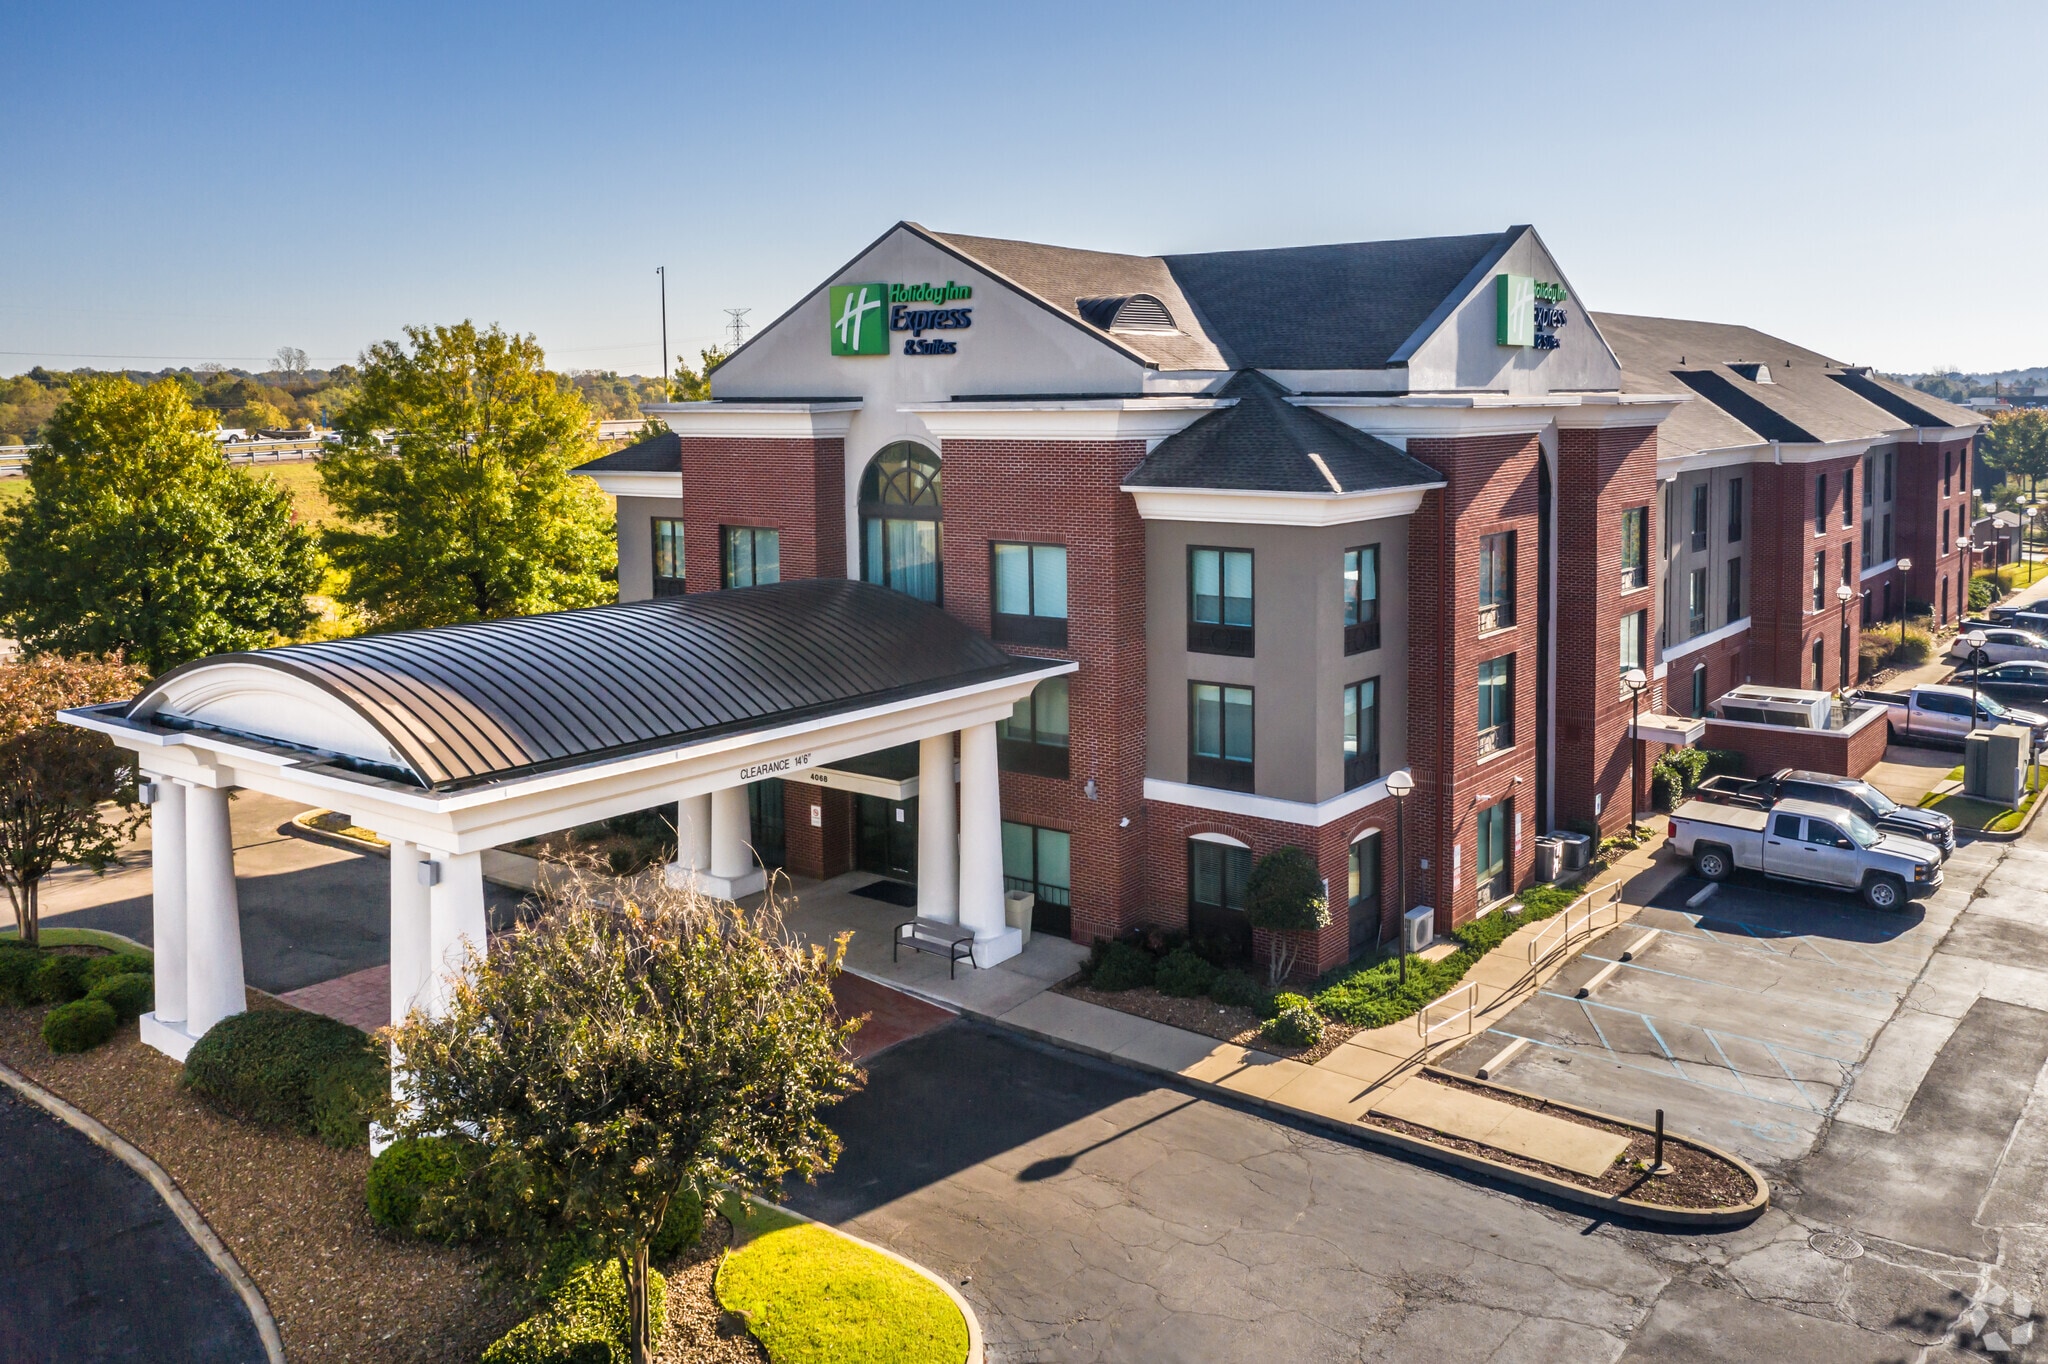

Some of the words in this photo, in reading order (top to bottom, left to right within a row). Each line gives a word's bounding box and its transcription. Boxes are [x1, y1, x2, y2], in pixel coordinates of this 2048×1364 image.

[890, 282, 945, 305] Holiday
[945, 281, 972, 300] Inn
[889, 305, 972, 337] Express
[903, 339, 915, 355] &
[916, 339, 957, 355] Suites
[740, 759, 790, 780] CLEARANCE
[810, 773, 828, 783] 4068
